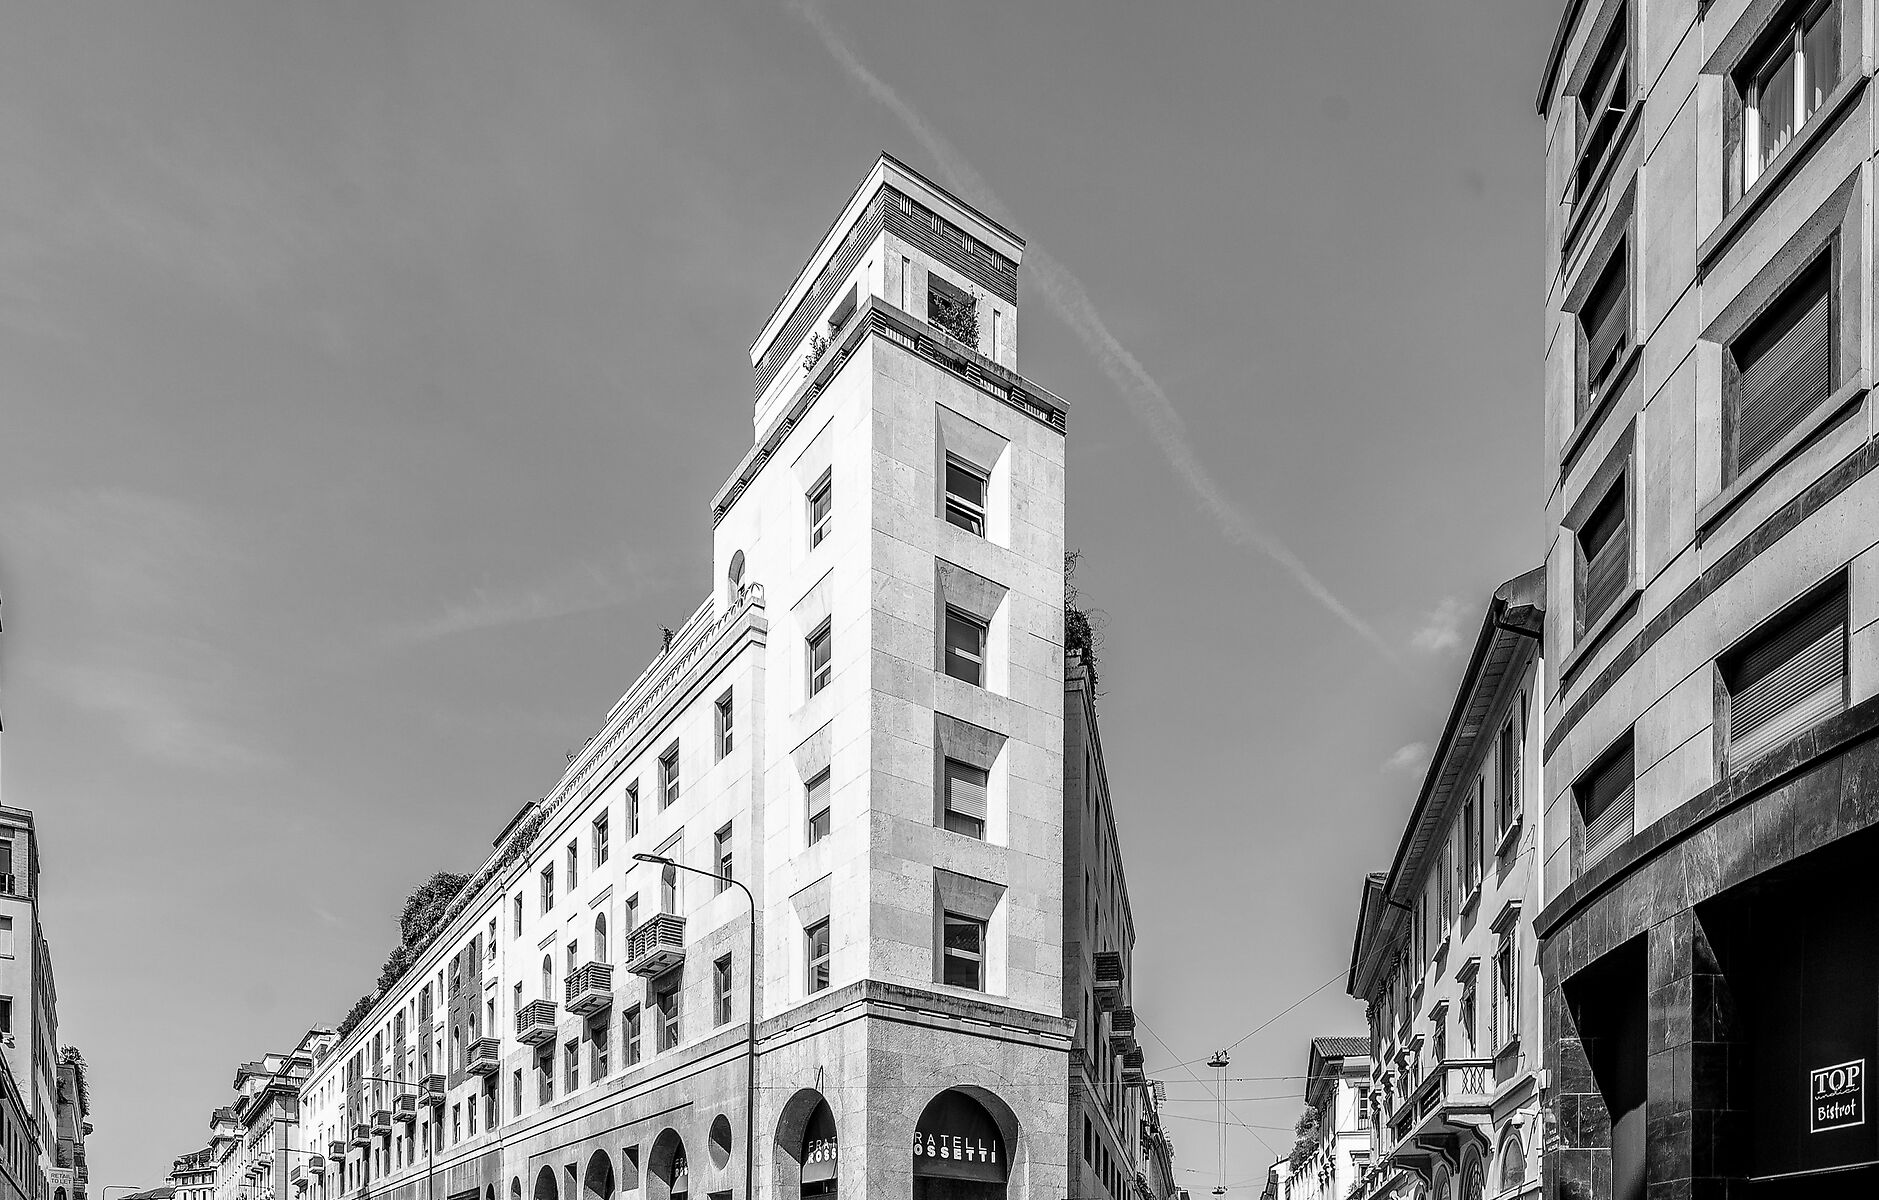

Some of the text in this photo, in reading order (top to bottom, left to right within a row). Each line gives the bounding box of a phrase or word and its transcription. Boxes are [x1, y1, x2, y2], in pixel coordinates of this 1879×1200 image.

[1814, 1066, 1860, 1094] TOP
[1818, 1098, 1856, 1121] Bistrot
[808, 1136, 837, 1150] FRAT
[914, 1132, 996, 1152] RATELLI
[808, 1148, 837, 1164] ROSS
[914, 1145, 996, 1164] OSSETTI
